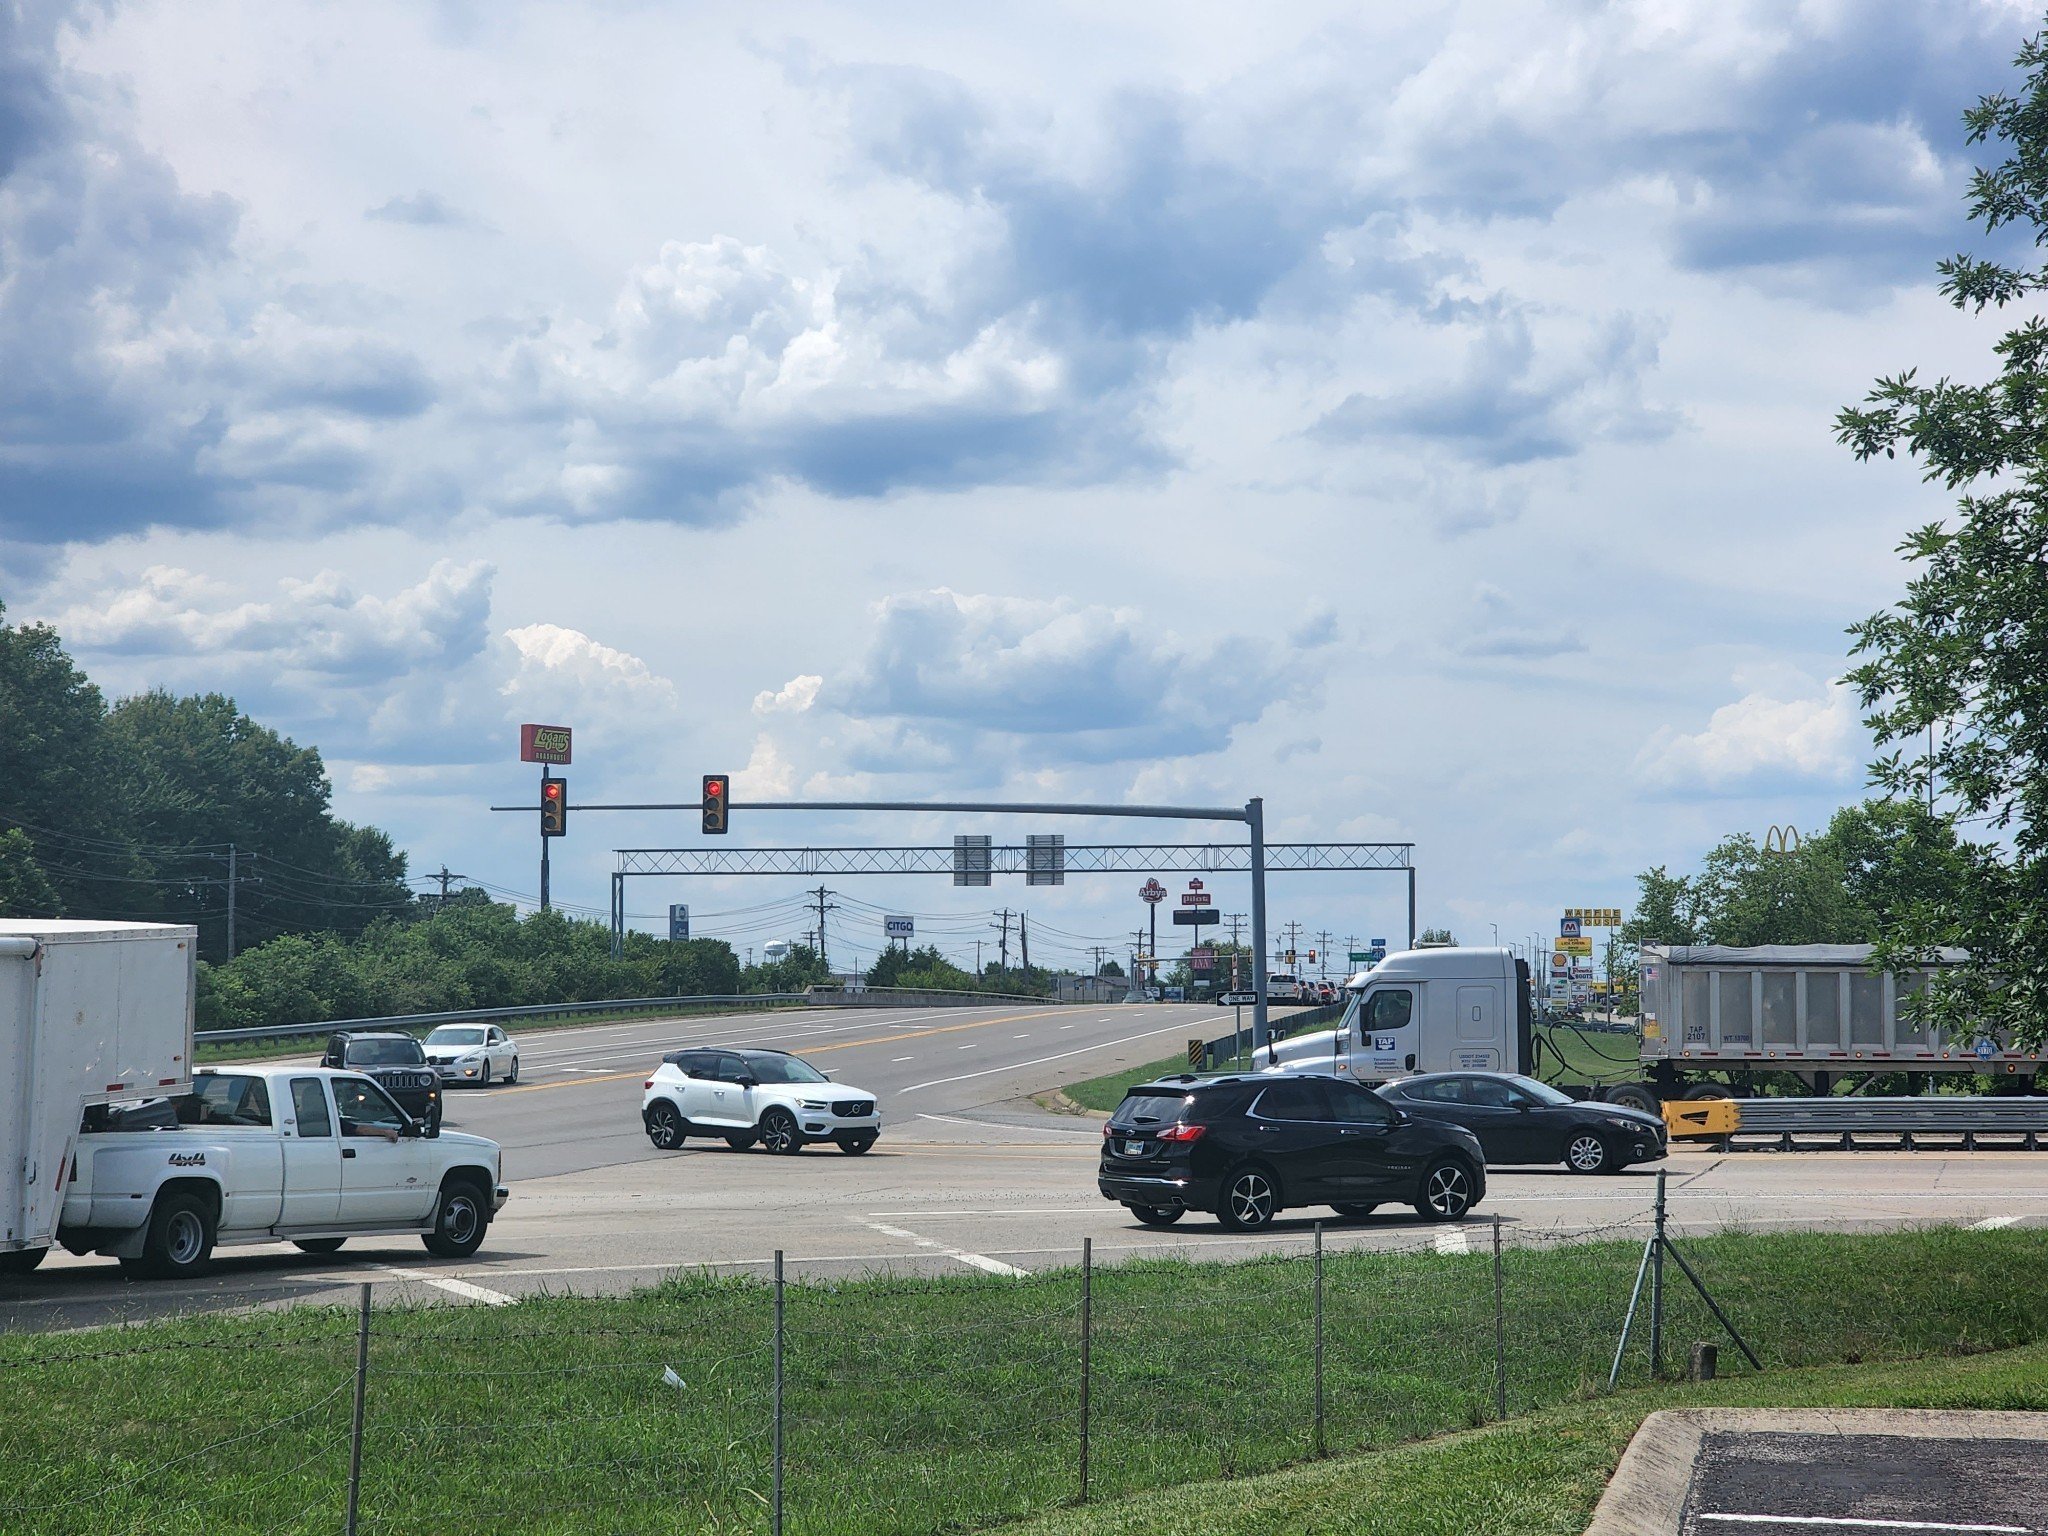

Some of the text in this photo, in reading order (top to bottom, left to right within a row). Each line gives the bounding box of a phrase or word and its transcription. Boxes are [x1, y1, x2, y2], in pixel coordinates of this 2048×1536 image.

[1140, 888, 1167, 898] Arby's
[1565, 909, 1621, 917] WAFFLE
[887, 921, 914, 931] CITGO
[1581, 918, 1621, 926] OUSE
[1373, 950, 1385, 960] 40
[1194, 959, 1209, 969] INN
[1228, 995, 1240, 1003] ONE
[169, 1153, 206, 1166] 4x4
